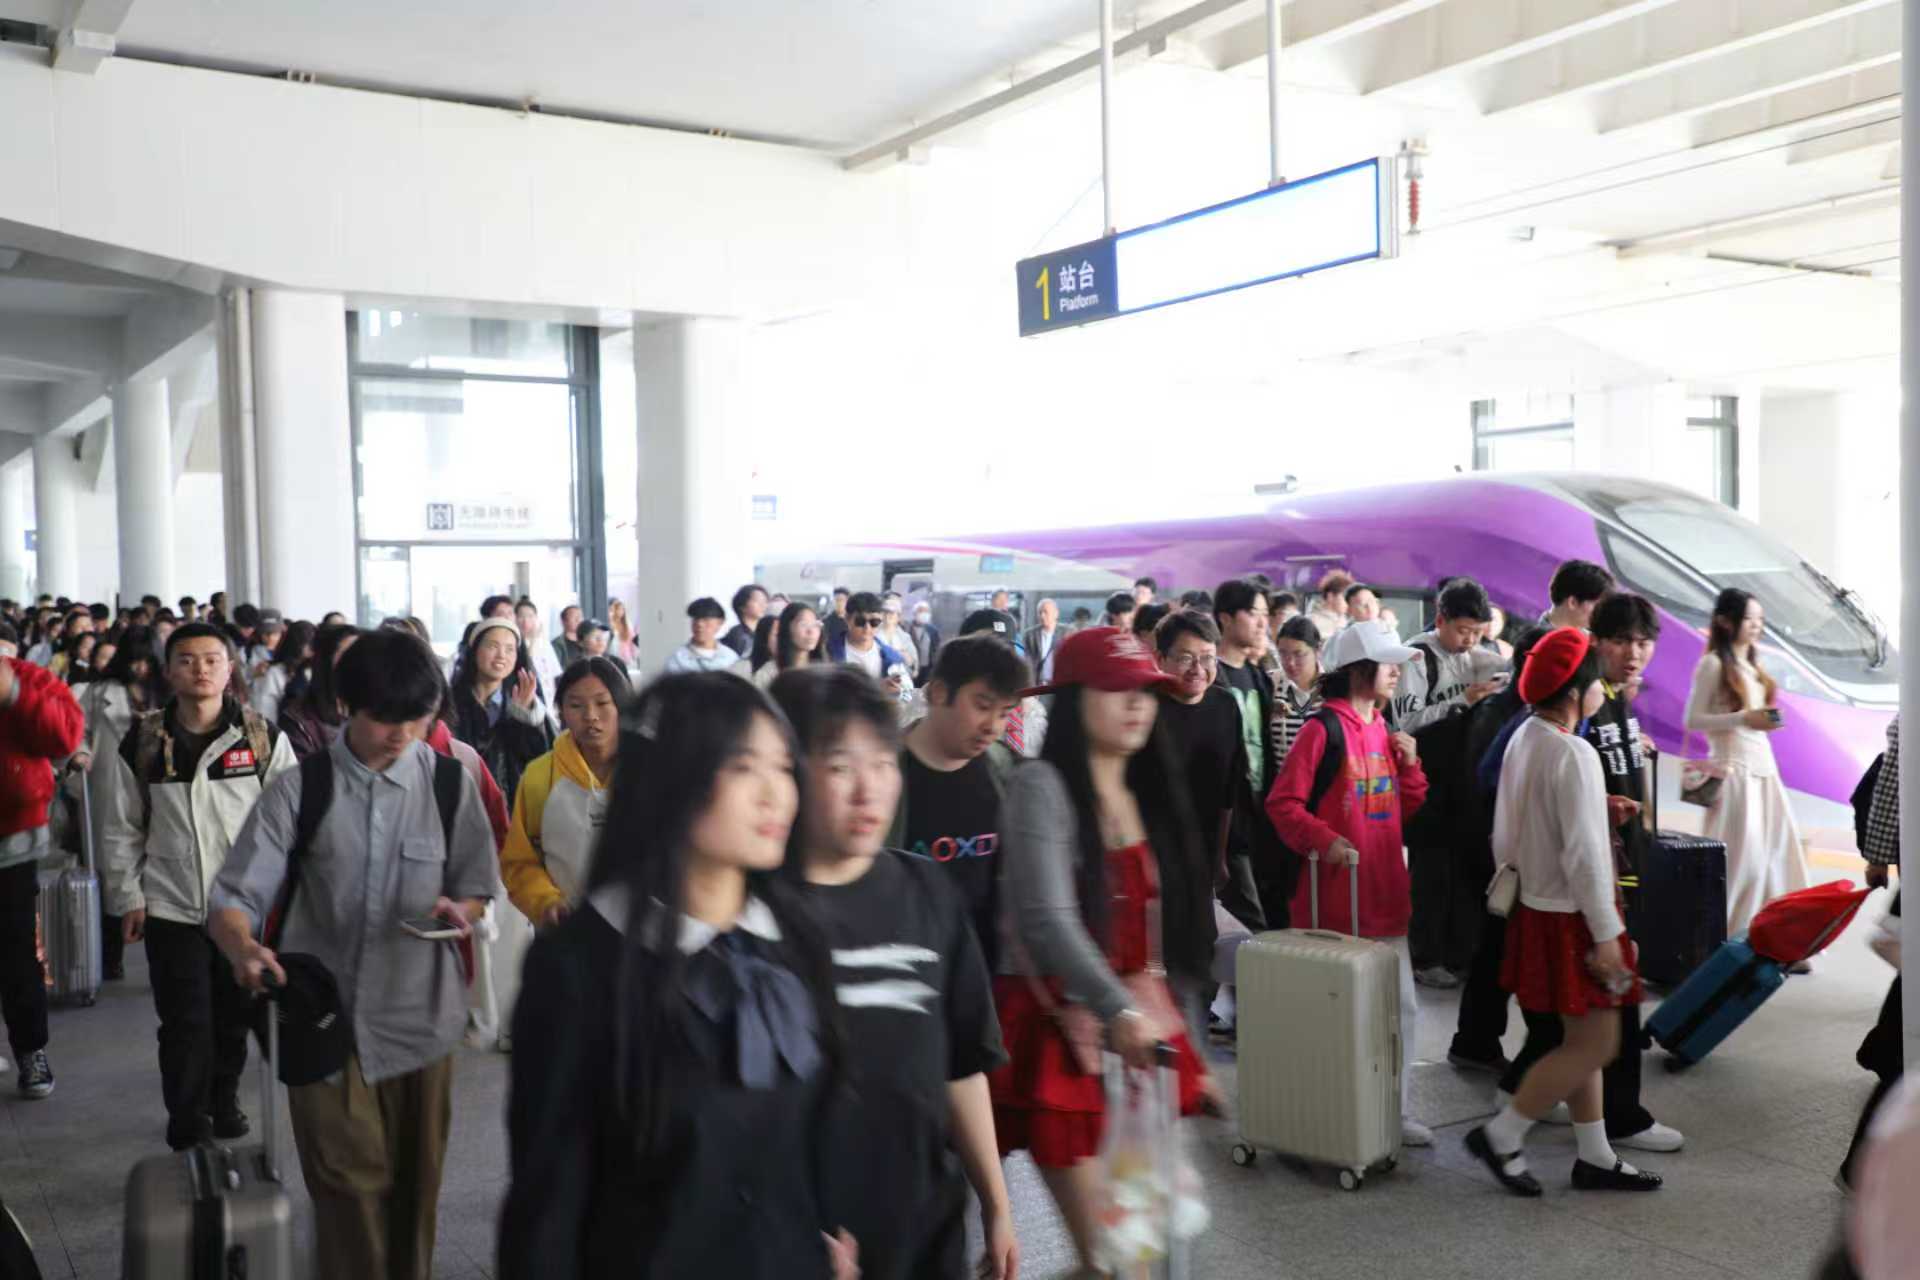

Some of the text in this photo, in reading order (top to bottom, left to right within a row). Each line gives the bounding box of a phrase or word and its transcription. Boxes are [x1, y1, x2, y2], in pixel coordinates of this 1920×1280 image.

[1035, 259, 1095, 321] 1 站台
[1059, 294, 1098, 312] Platform
